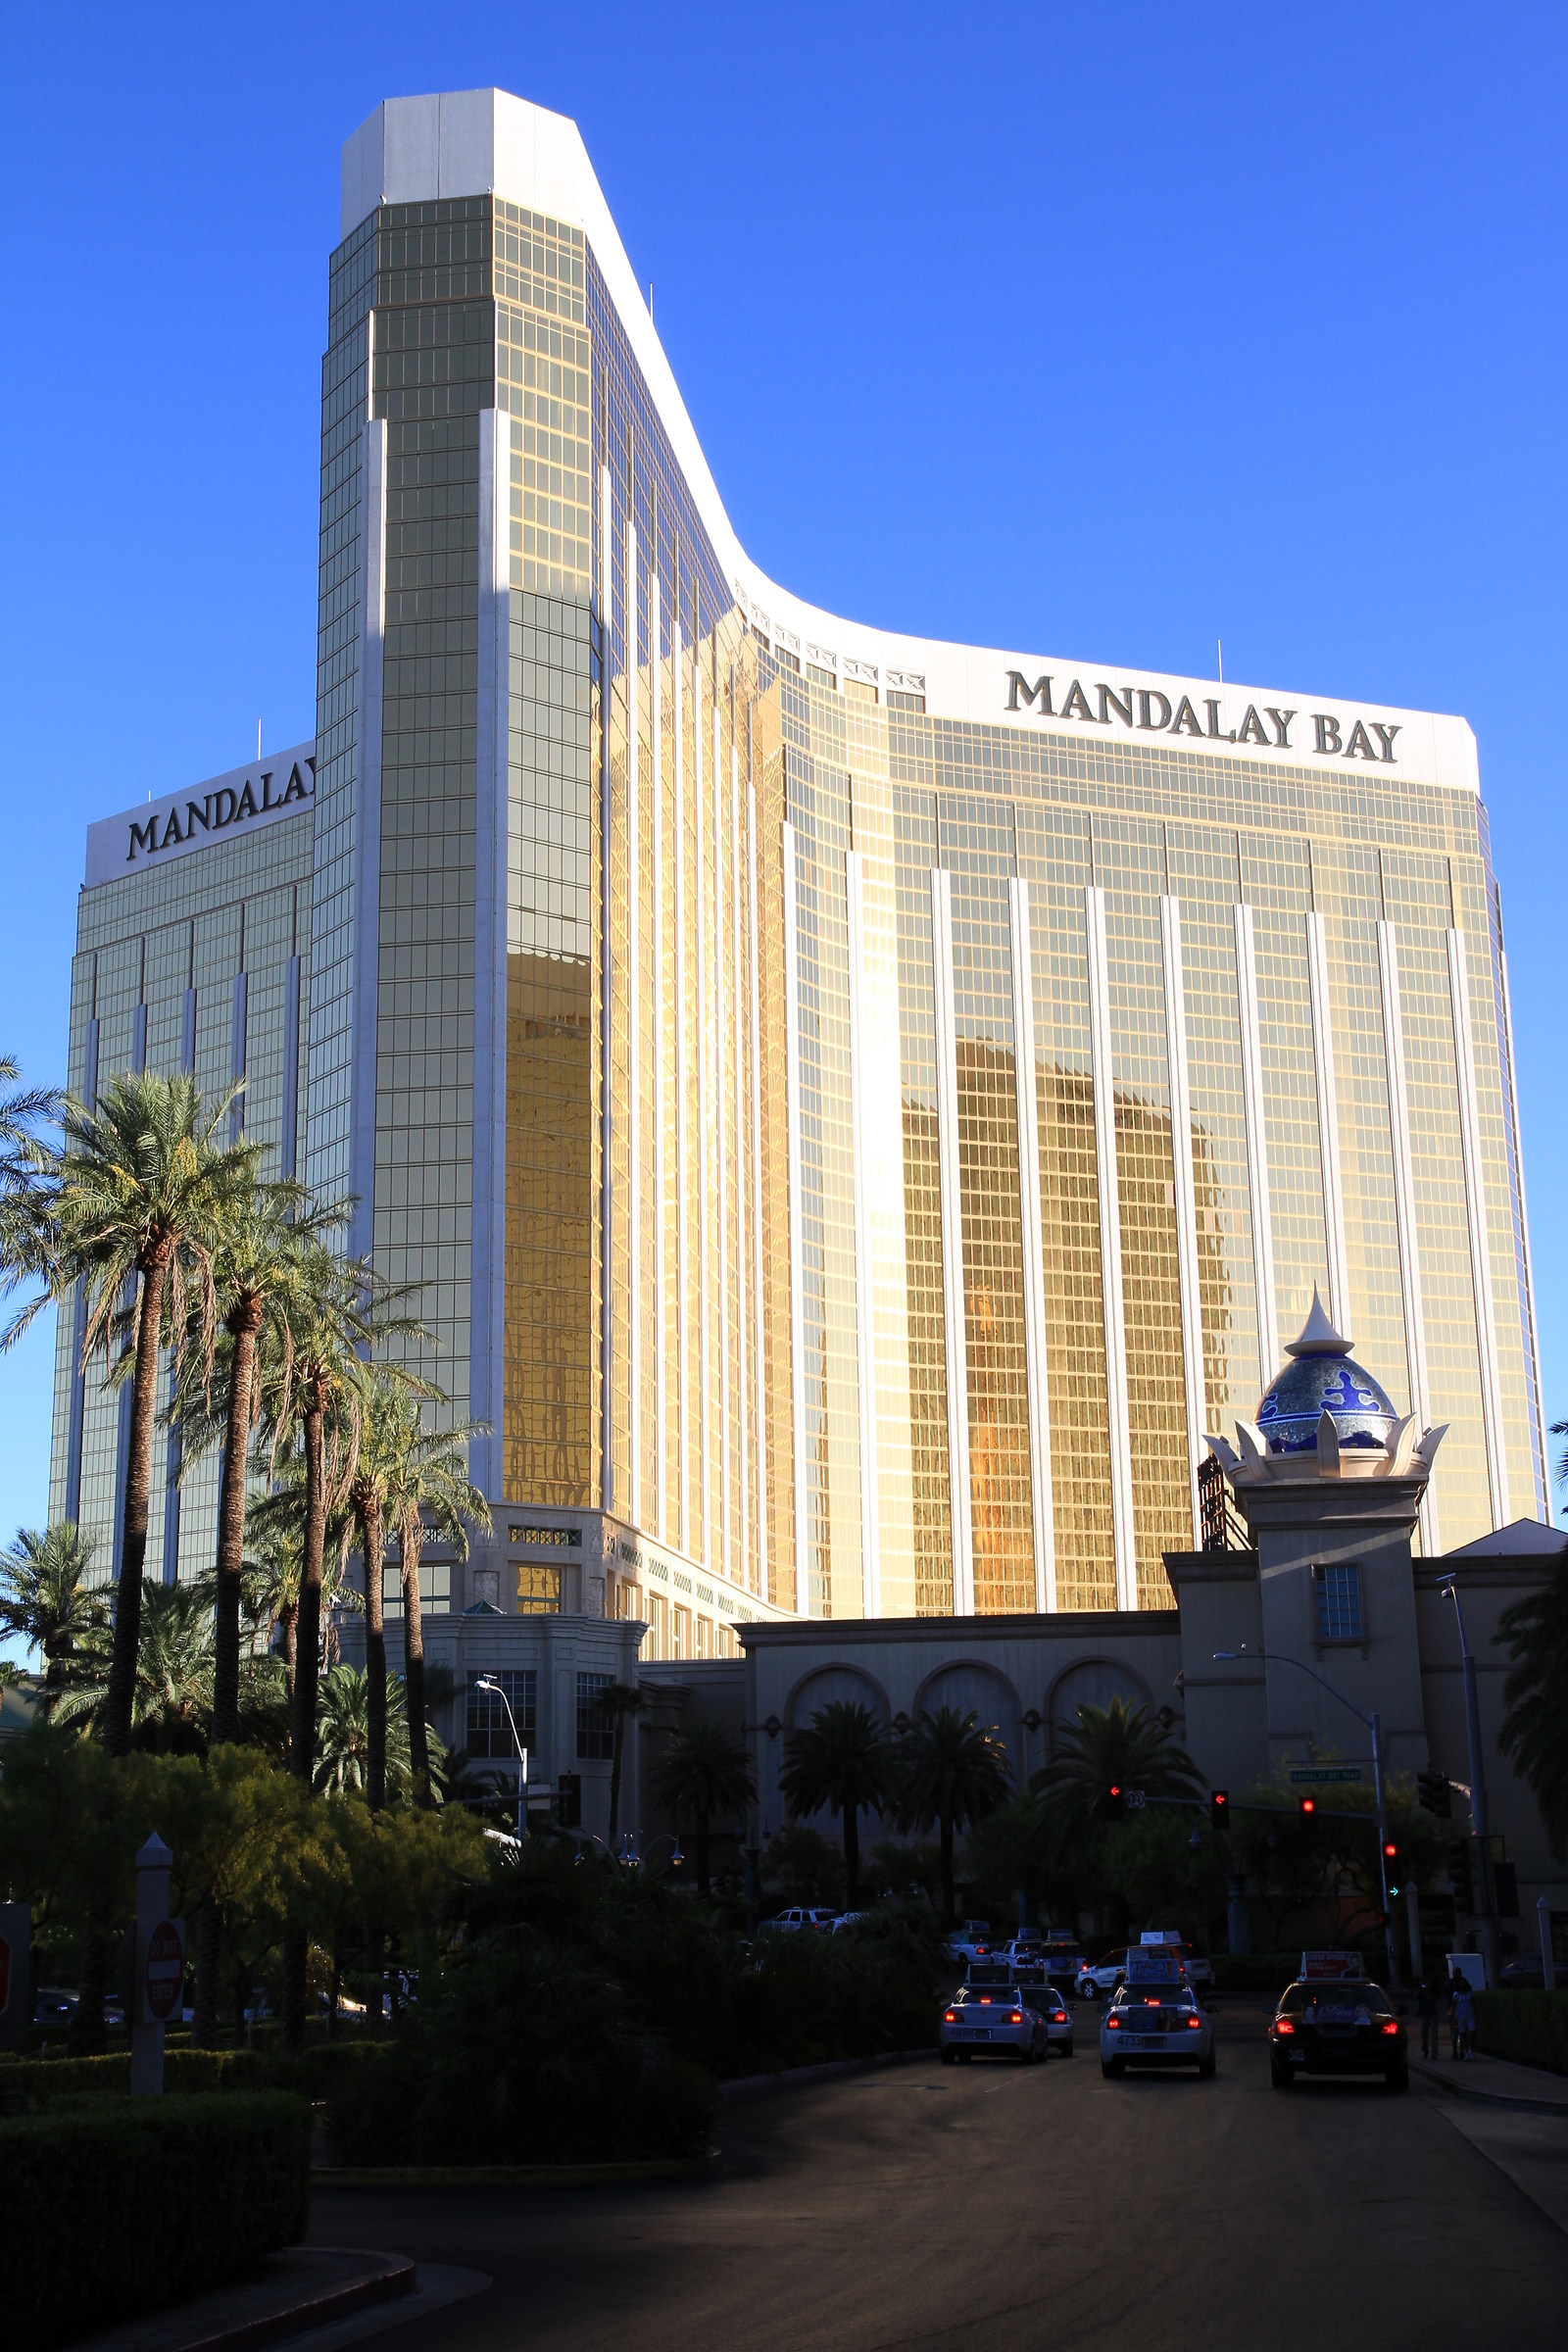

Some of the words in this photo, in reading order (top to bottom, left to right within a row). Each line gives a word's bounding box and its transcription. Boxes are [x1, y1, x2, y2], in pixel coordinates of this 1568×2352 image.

[1004, 670, 1298, 748] MANDALAY
[1311, 713, 1402, 763] BAY
[1293, 1772, 1326, 1782] MANDALAY
[1328, 1772, 1341, 1781] BAY
[151, 1940, 161, 1956] DO
[163, 1939, 177, 1954] NOT
[1130, 1961, 1165, 1973] TAO
[152, 1984, 173, 2000] ENTER
[950, 2027, 971, 2037] 4819
[1117, 2034, 1142, 2046] 4733
